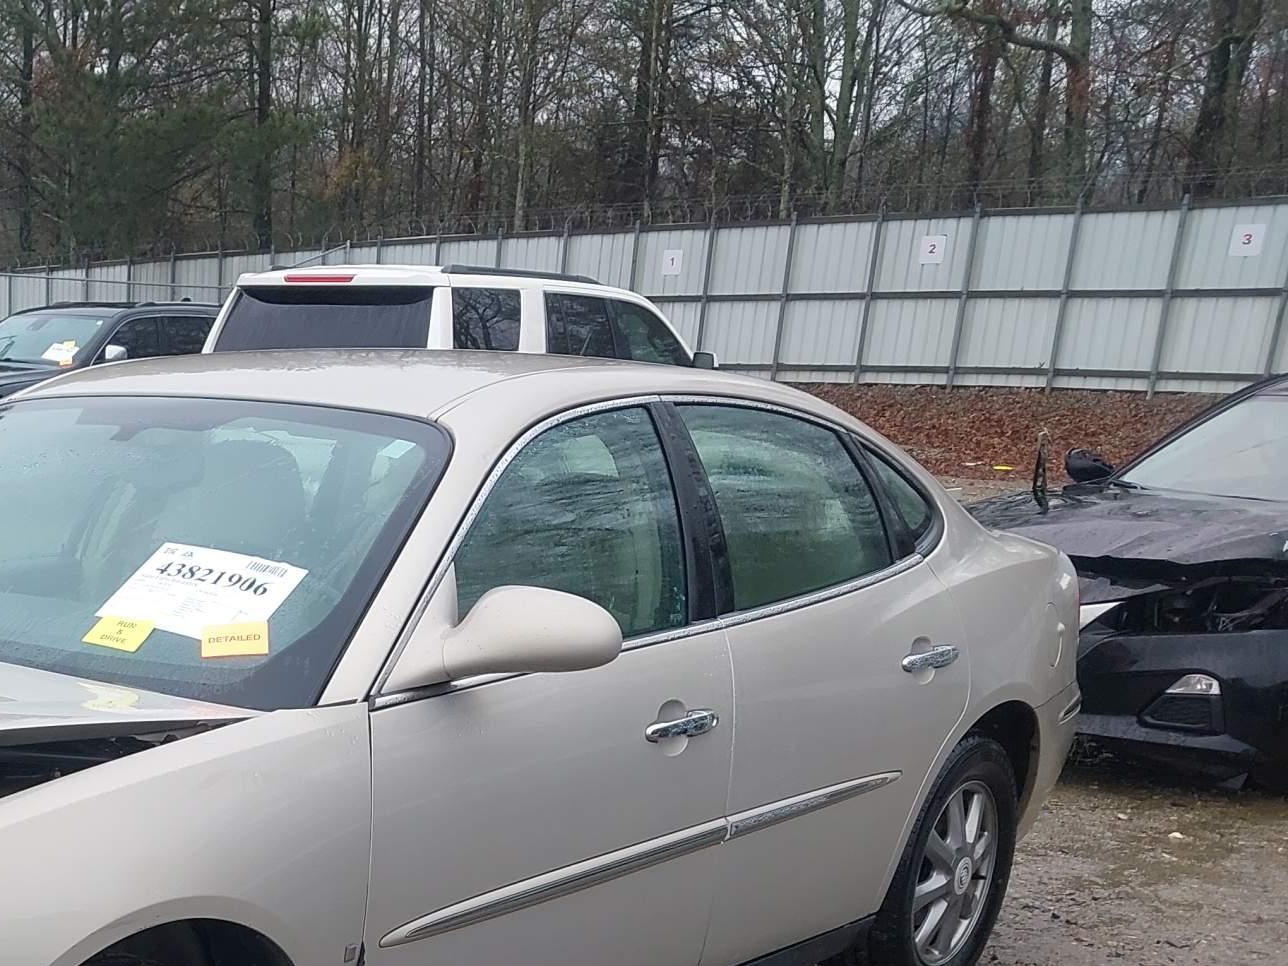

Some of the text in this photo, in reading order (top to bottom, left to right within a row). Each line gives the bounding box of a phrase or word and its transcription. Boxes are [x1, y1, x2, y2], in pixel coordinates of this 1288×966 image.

[1242, 233, 1253, 245] 3
[927, 243, 937, 254] 2
[669, 256, 675, 267] 1
[155, 561, 269, 596] 43821906
[208, 633, 261, 644] DETAILED
